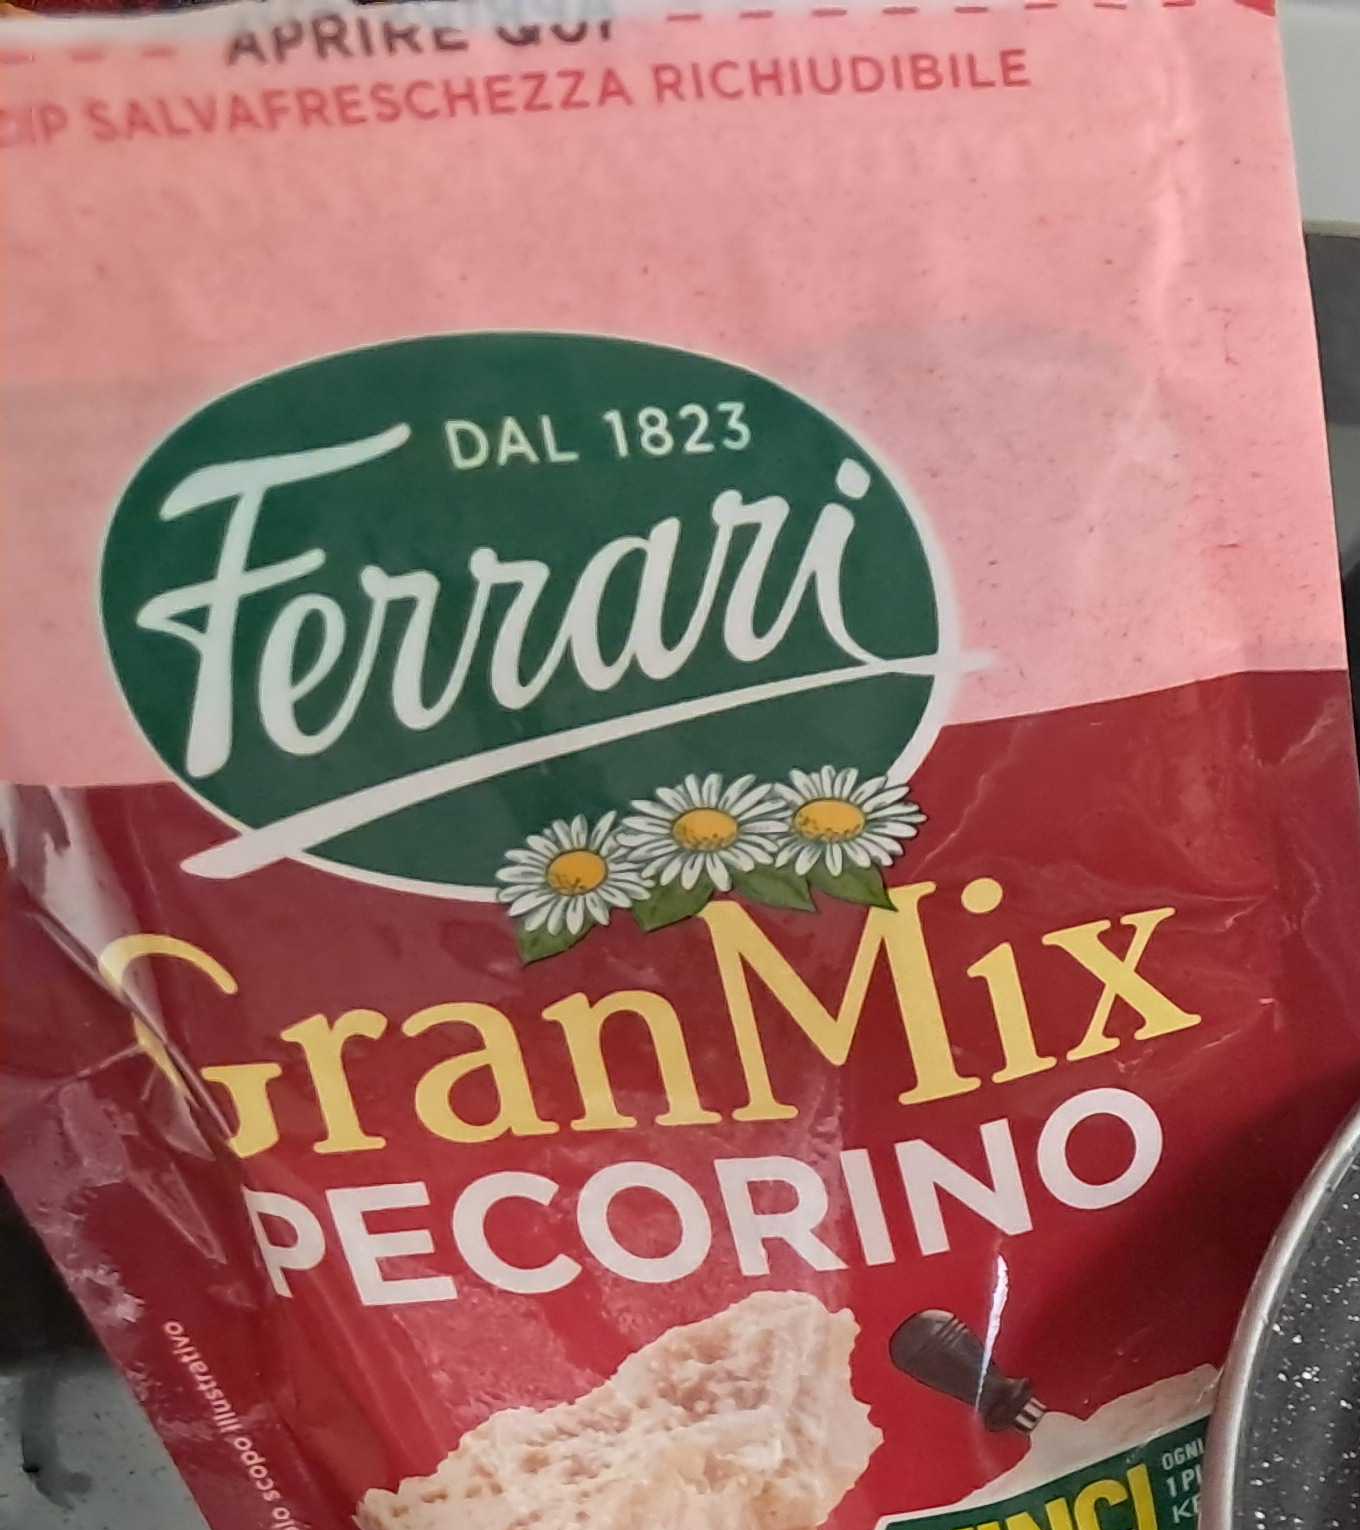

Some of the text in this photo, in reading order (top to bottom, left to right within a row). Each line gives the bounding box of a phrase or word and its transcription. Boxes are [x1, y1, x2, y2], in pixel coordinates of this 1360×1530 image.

[85, 69, 632, 141] SALVAFRESCHEZZA
[653, 49, 1031, 103] RICHIUDIBILE
[445, 402, 750, 470] DAL 1823
[138, 424, 940, 785] Ferrari
[98, 877, 1201, 1159] GranMix
[246, 1087, 1163, 1305] PECORINO
[165, 1321, 242, 1433] illustrativo
[234, 1437, 280, 1502] scopo
[1161, 1438, 1204, 1470] OGNI
[1166, 1477, 1178, 1497] 1
